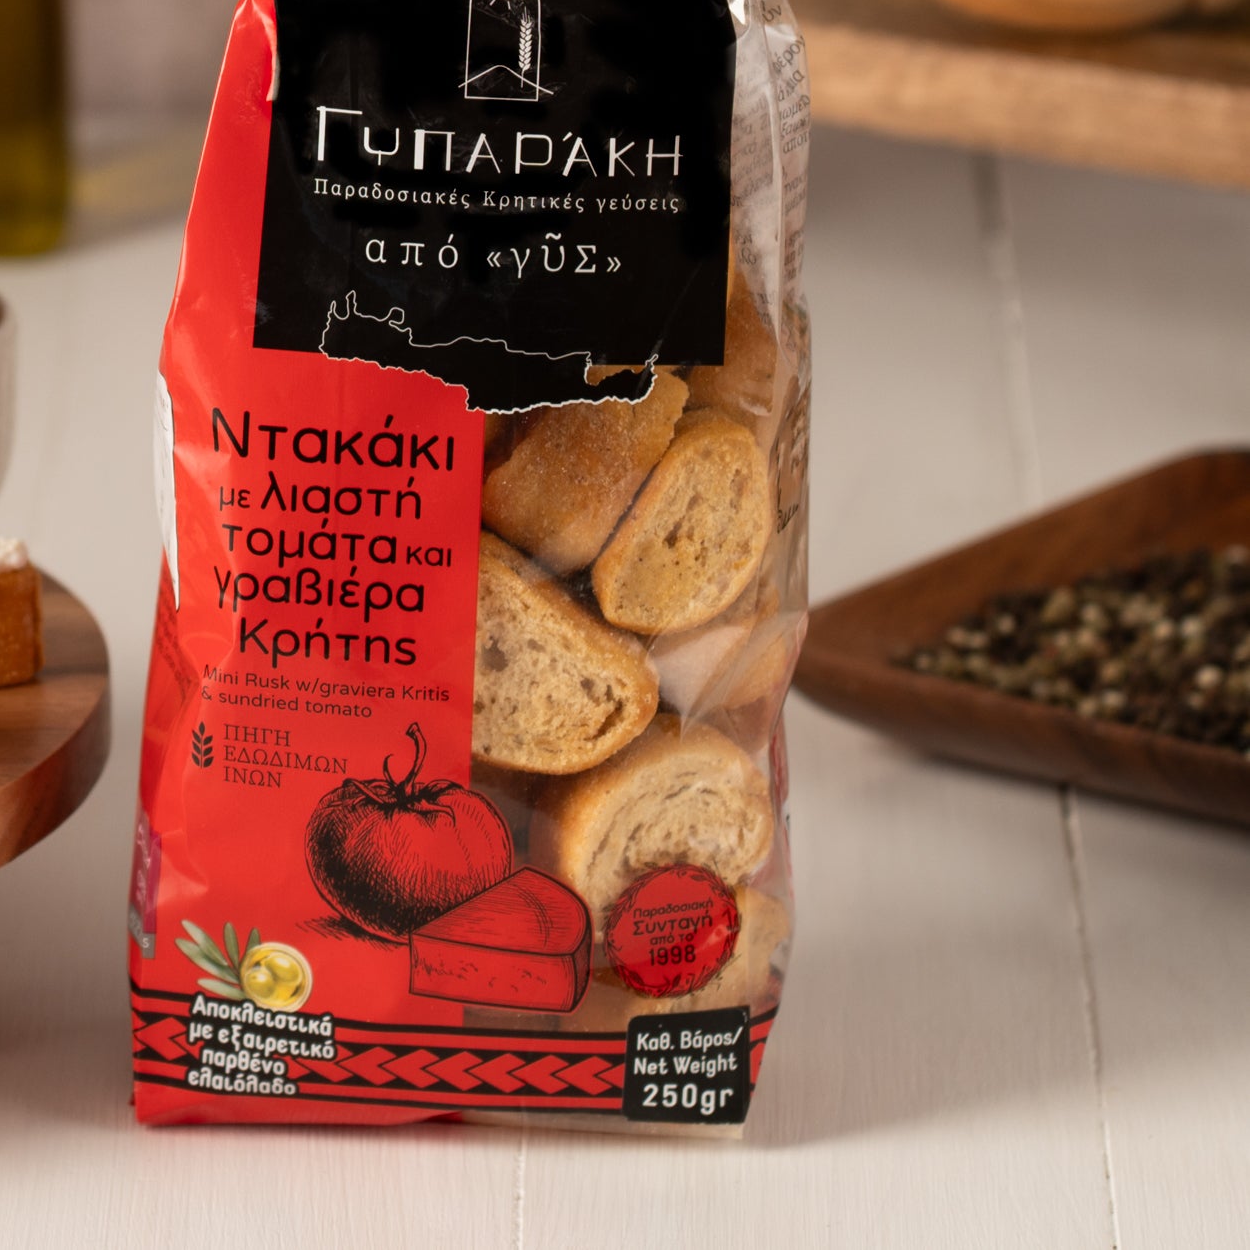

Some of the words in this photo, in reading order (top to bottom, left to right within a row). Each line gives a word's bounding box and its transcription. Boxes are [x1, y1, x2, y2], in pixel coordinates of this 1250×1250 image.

[313, 178, 471, 210] Παραδοσιακές
[482, 190, 585, 213] Κρητικές
[596, 192, 680, 214] γεύσεις
[364, 233, 460, 270] από
[211, 406, 455, 472] Ντακάκι
[218, 485, 251, 512] με
[260, 470, 422, 520] λιαστή
[221, 517, 397, 569] τομάτα
[405, 545, 452, 568] και
[213, 565, 425, 623] γραβιέρα
[238, 617, 418, 669] Κρήτης
[202, 664, 239, 686] Mini
[244, 672, 290, 692] Rusk
[295, 677, 396, 701] w/graviera
[401, 685, 451, 702] Kritis
[200, 684, 213, 701] &
[217, 689, 299, 712] sundried
[304, 700, 373, 719] tomato
[222, 722, 292, 748] ΠΗΓΗ
[222, 746, 348, 775] ΕΔΩΔΙΜΩΝ
[222, 766, 283, 789] ΙΝΩΝ
[631, 909, 714, 937] Συνταγή
[632, 898, 715, 920] Παραδοσιακή
[649, 931, 676, 948] από
[678, 932, 695, 944] το
[648, 944, 697, 967] 1998
[191, 996, 333, 1037] Αποκλειστικά
[188, 1022, 214, 1042] με
[636, 1032, 676, 1052] Καθ.
[201, 1047, 287, 1077] παρθένο
[633, 1056, 668, 1076] Net
[673, 1052, 739, 1078] Weight
[187, 1068, 297, 1096] ελαιόλαδο
[641, 1082, 735, 1116] 250gr
